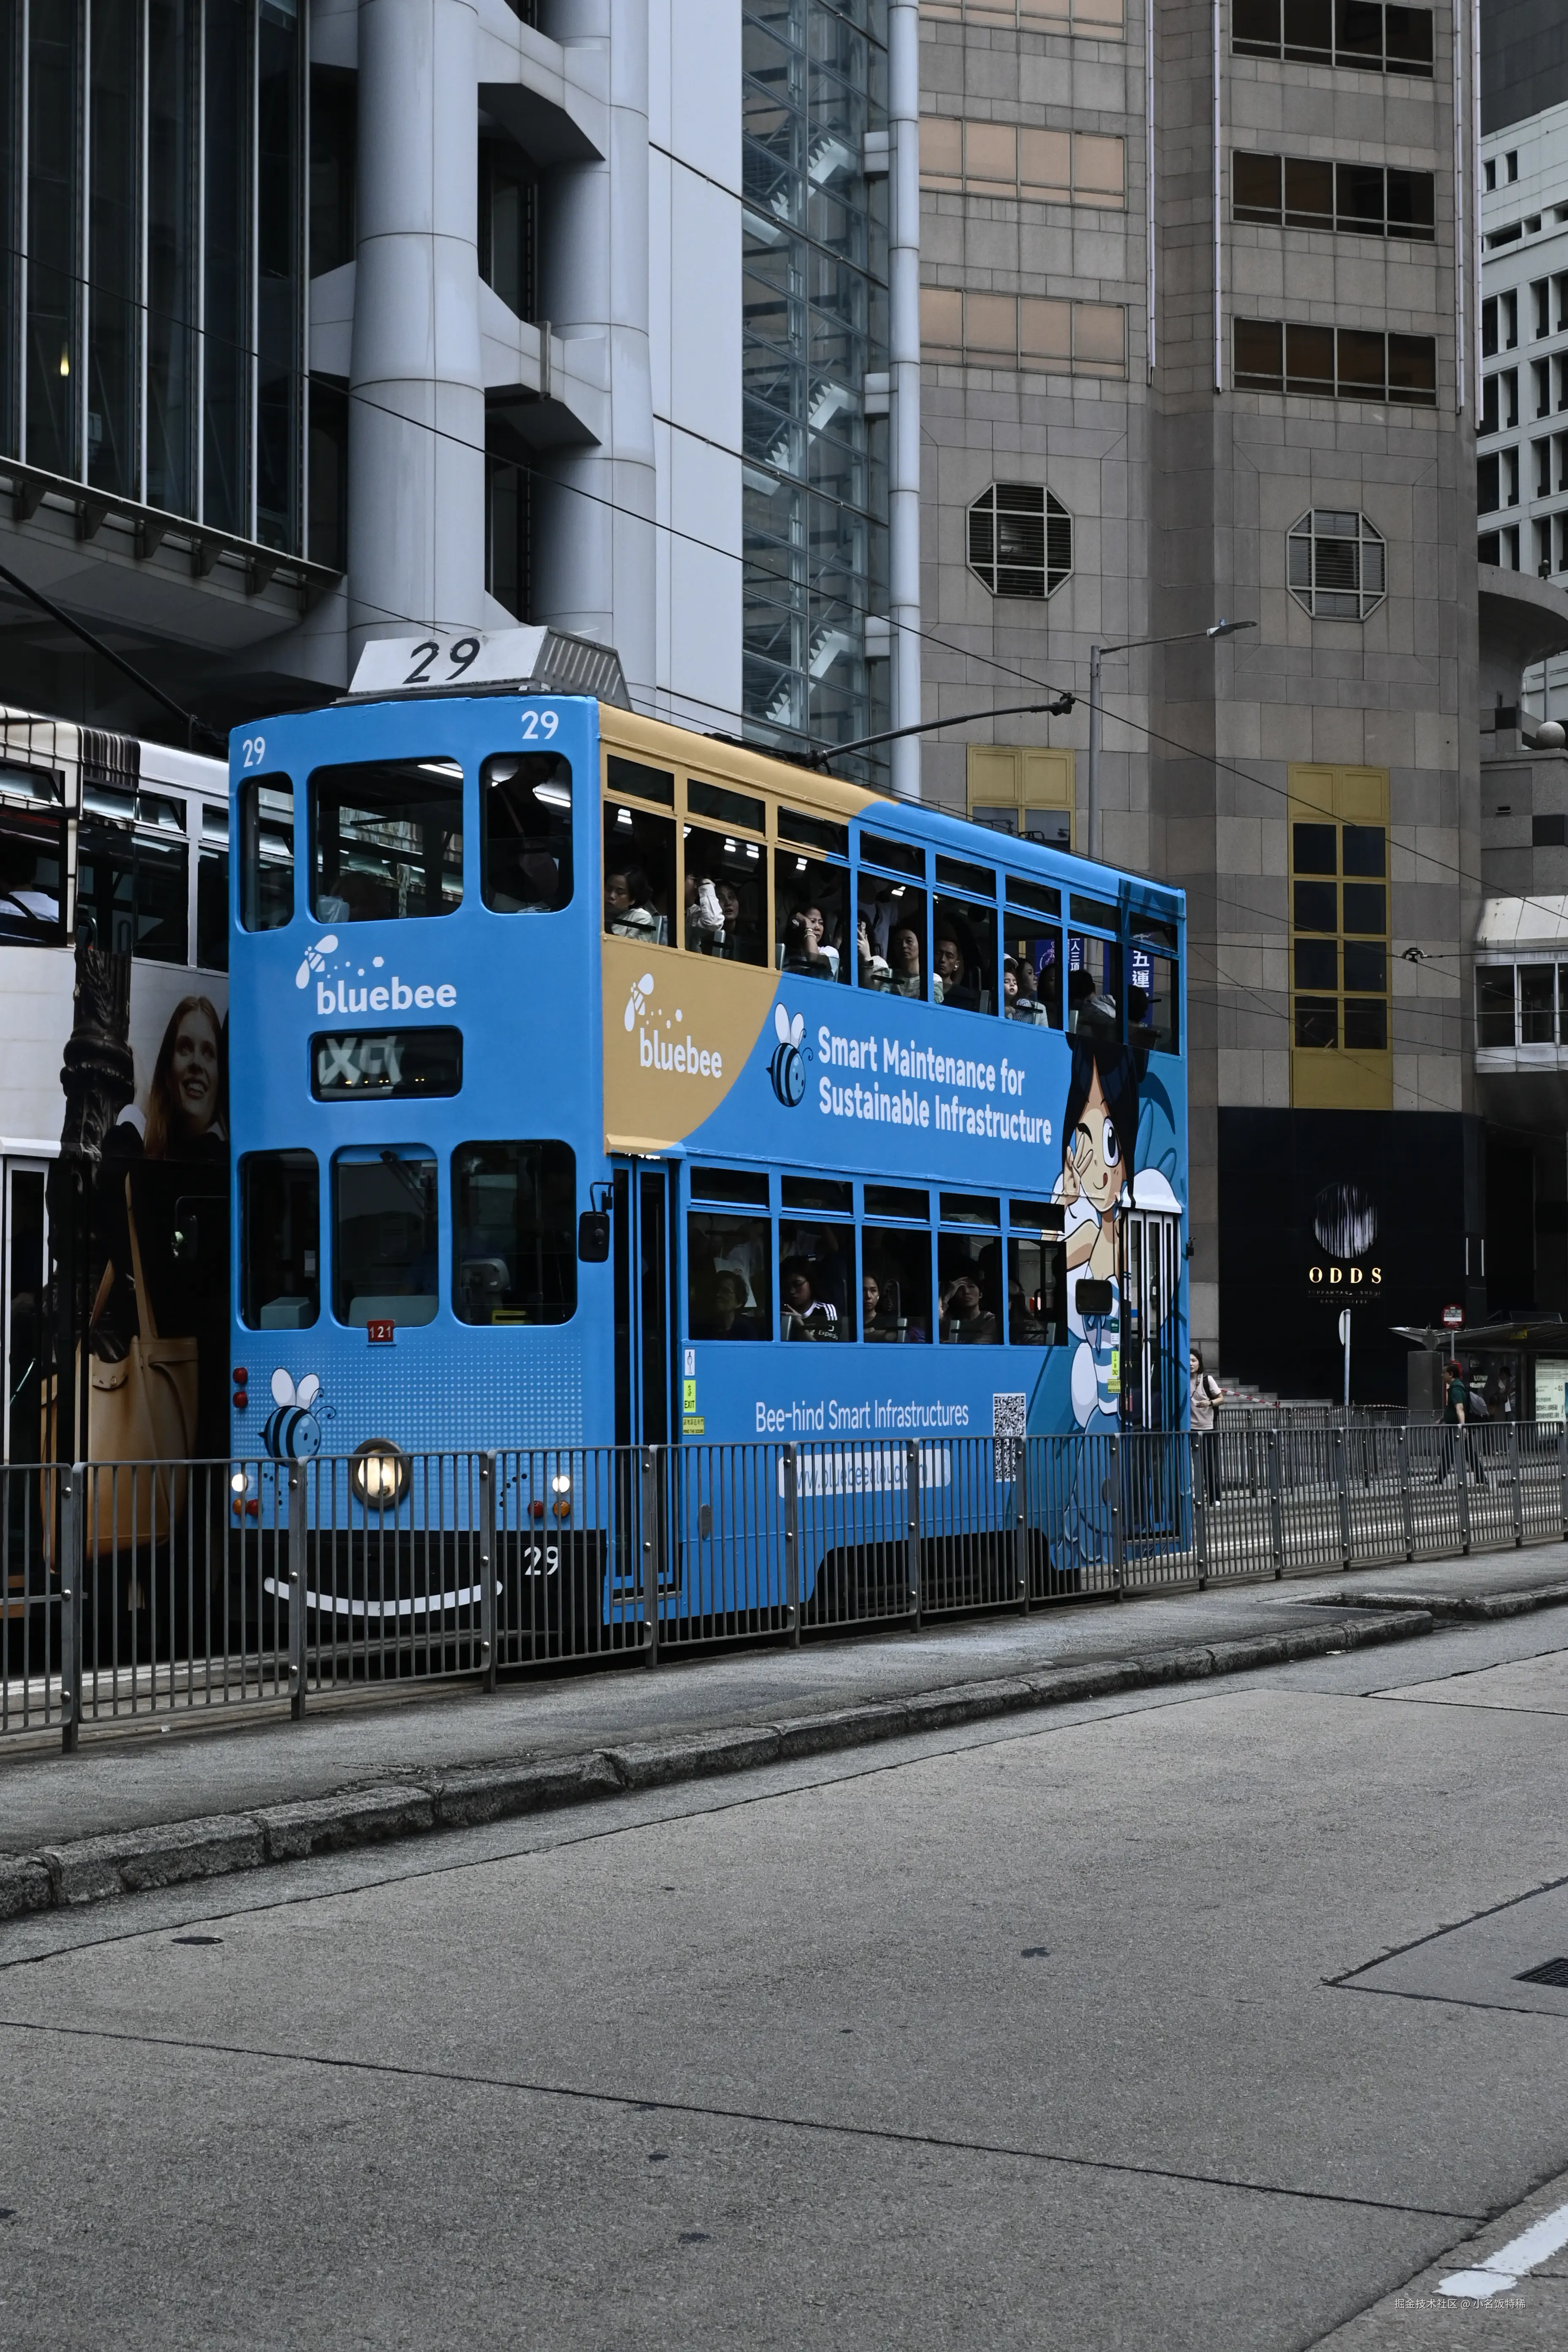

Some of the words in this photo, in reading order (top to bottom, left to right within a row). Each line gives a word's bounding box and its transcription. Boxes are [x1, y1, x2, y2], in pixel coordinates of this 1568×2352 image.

[403, 637, 480, 684] 29
[521, 710, 559, 739] 29
[242, 737, 265, 767] 29
[1070, 938, 1080, 971] 人三項
[317, 977, 457, 1015] bluebee
[640, 1027, 722, 1078] bluebee
[818, 1026, 877, 1072] Smart
[883, 1038, 996, 1092] Maintenance
[1001, 1058, 1025, 1096] for
[819, 1076, 929, 1128] Sustainable
[935, 1095, 1052, 1146] Infrastructure
[1309, 1267, 1382, 1284] ODDS
[370, 1326, 391, 1338] 121
[684, 1400, 695, 1409] EXIT
[756, 1401, 824, 1432] Bee-hind
[829, 1399, 871, 1430] Smart
[874, 1399, 969, 1428] Infrastructures
[524, 1546, 558, 1575] 29
